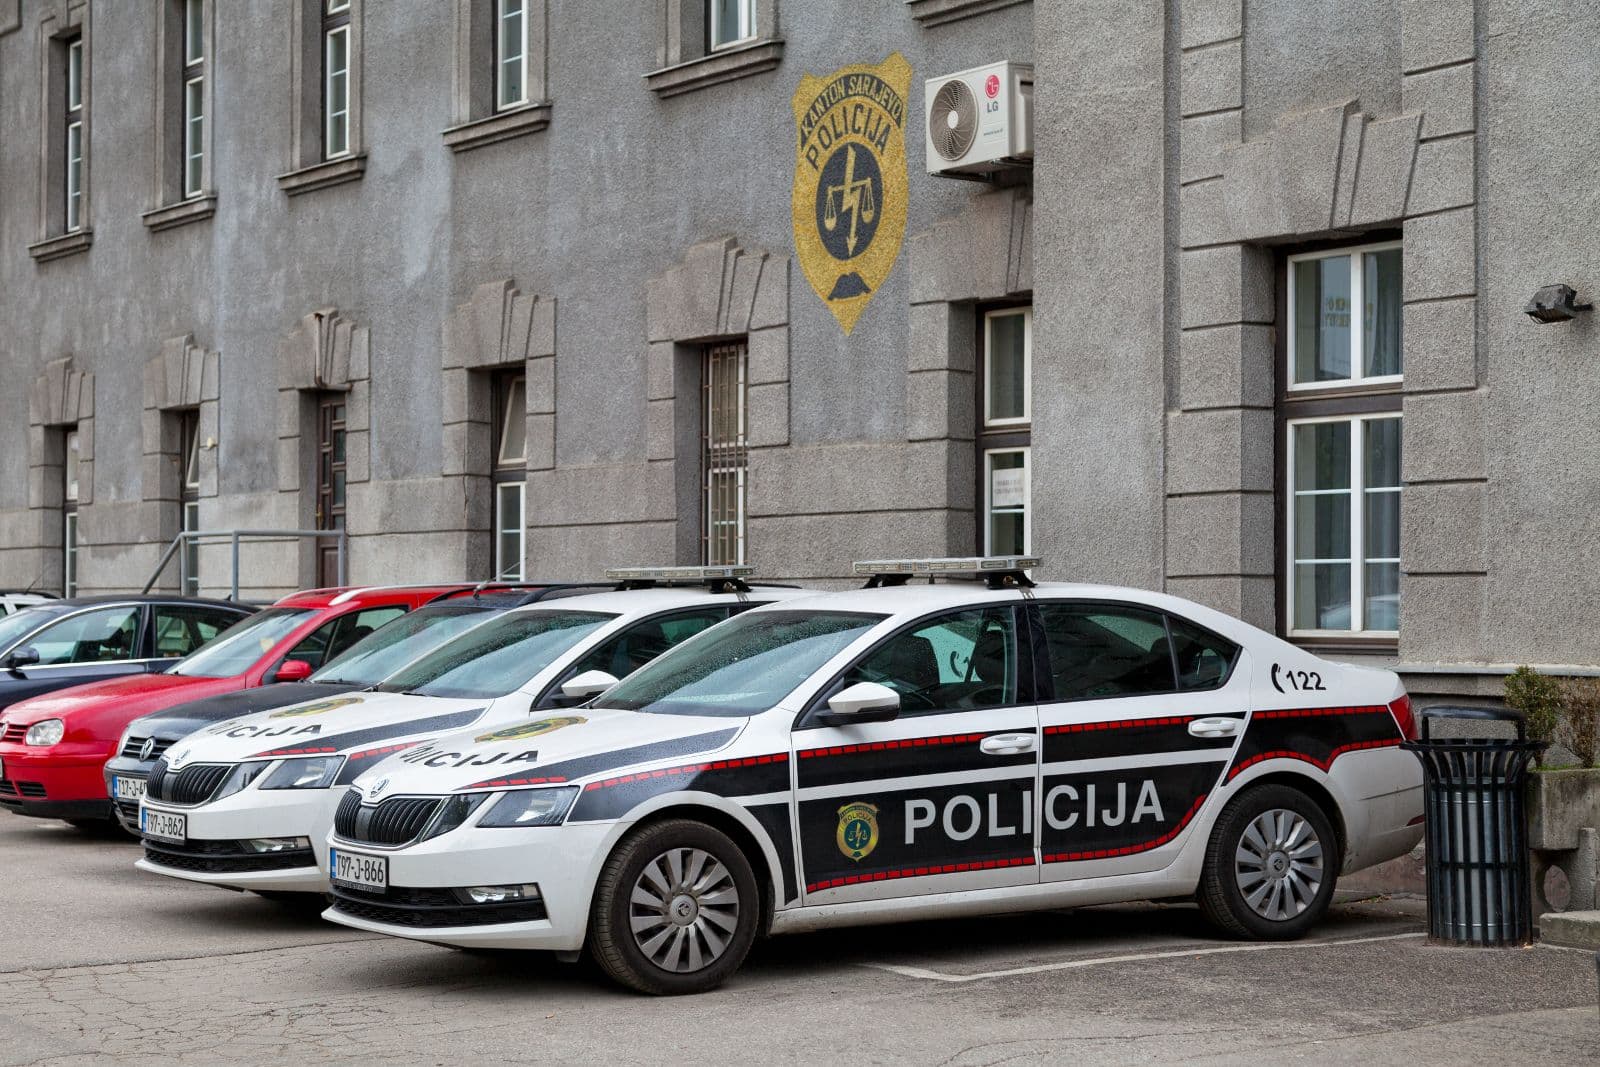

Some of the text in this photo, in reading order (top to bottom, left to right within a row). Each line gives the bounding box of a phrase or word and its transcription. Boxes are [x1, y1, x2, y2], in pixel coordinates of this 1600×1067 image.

[802, 75, 902, 138] KANTON SARAJEVO
[986, 101, 999, 113] LG
[806, 103, 891, 171] POLICIJA
[1286, 670, 1327, 690] 122
[146, 813, 184, 837] T97-J-862
[905, 779, 1165, 844] POLICIJA
[336, 854, 384, 883] T97-J-866
